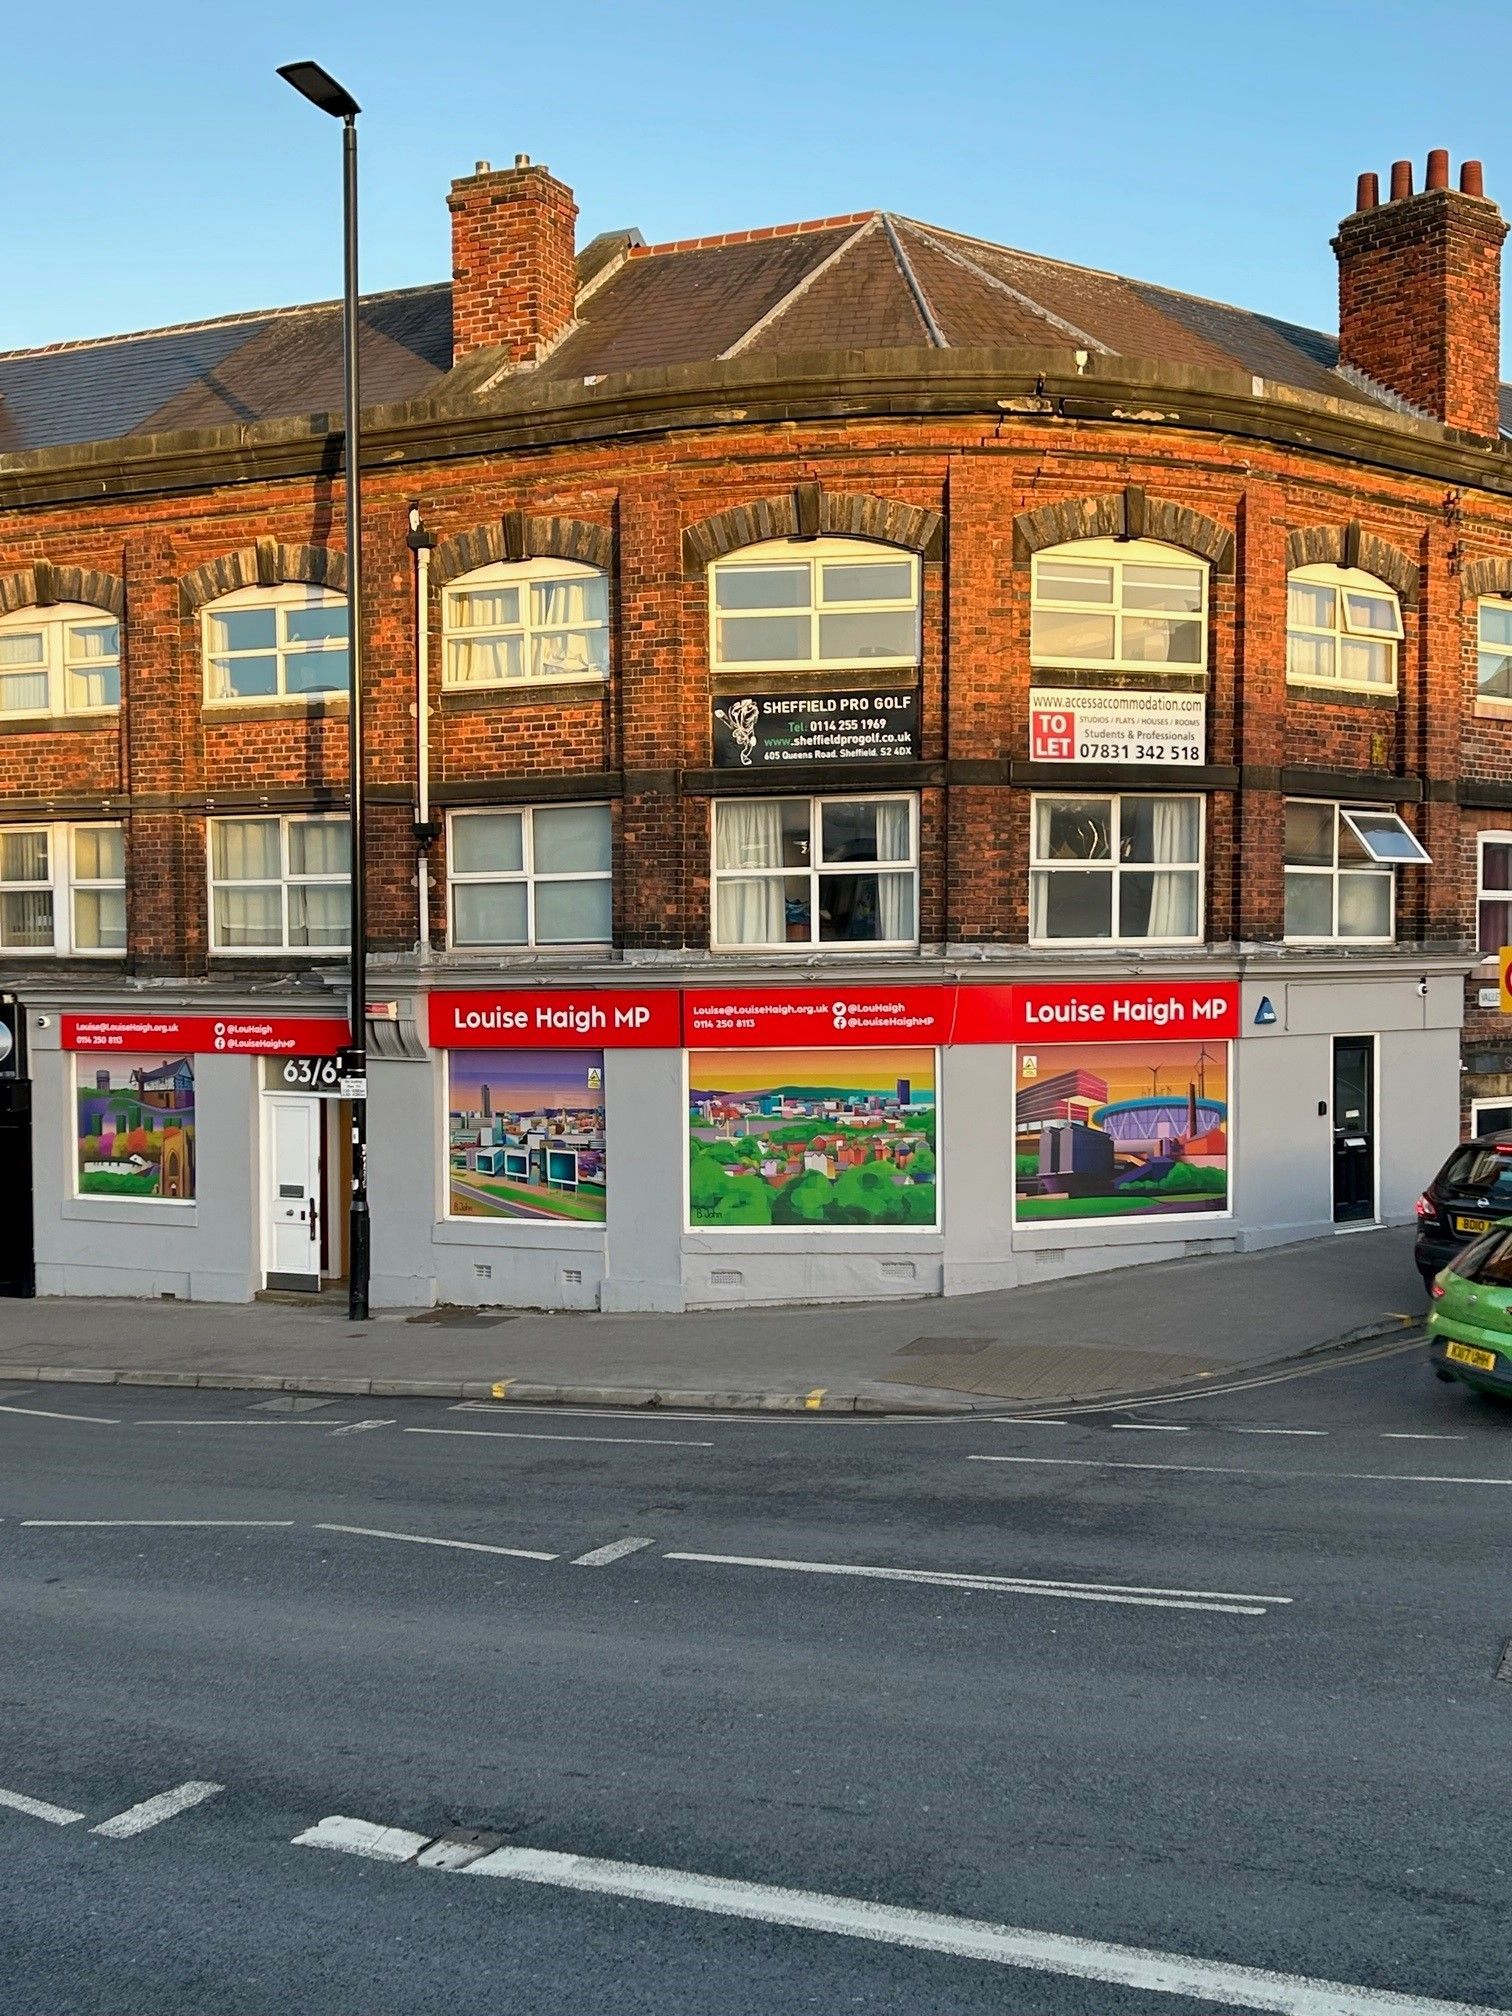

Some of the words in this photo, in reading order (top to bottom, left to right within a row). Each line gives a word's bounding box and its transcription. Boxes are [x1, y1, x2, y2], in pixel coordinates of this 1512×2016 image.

[763, 700, 837, 714] SHEFFIELD
[840, 698, 869, 712] PRO
[874, 696, 912, 710] GOLF
[1033, 695, 1202, 712] www.accessaccommodation.com
[810, 720, 836, 732] 0114
[838, 719, 858, 731] 255
[861, 718, 887, 730] 1969
[1039, 714, 1067, 734] TO
[1079, 716, 1109, 724] STUDIOS
[1115, 716, 1135, 725] FLATS
[1141, 718, 1169, 726] HOUSES
[1174, 719, 1200, 727] ROOMS
[764, 732, 912, 747] www.sheffieldprogolf.co.uk
[1084, 728, 1125, 739] Students
[1127, 730, 1135, 739] &
[1136, 731, 1195, 741] Professionals
[764, 751, 781, 761] 605
[782, 750, 813, 760] Queens
[880, 747, 892, 757] S2
[893, 747, 912, 756] 4DX
[1035, 737, 1072, 757] LET
[1080, 743, 1130, 759] 07831
[1135, 745, 1164, 760] 342
[1170, 746, 1200, 761] 518
[693, 1003, 828, 1016] Louise@LouiseHaigh.org.uk
[847, 1003, 905, 1014] @LouHaigh
[1025, 998, 1105, 1023] Louise
[1113, 997, 1185, 1026] Haigh
[1192, 998, 1227, 1020] MP
[454, 1005, 528, 1028] Louise
[535, 1005, 606, 1033] Haigh
[614, 1006, 650, 1028] MP
[693, 1019, 714, 1029] 0114
[715, 1018, 734, 1028] 250
[736, 1018, 756, 1028] 8113
[847, 1016, 934, 1028] @LouiseHaighMP
[76, 1022, 179, 1034] Louise@LouiseHaigh.org.uk
[227, 1024, 272, 1035] @LouHaigh
[92, 1035, 107, 1045] 250
[227, 1038, 296, 1050] @LouiseHaighMP
[283, 1058, 343, 1086] 63/6
